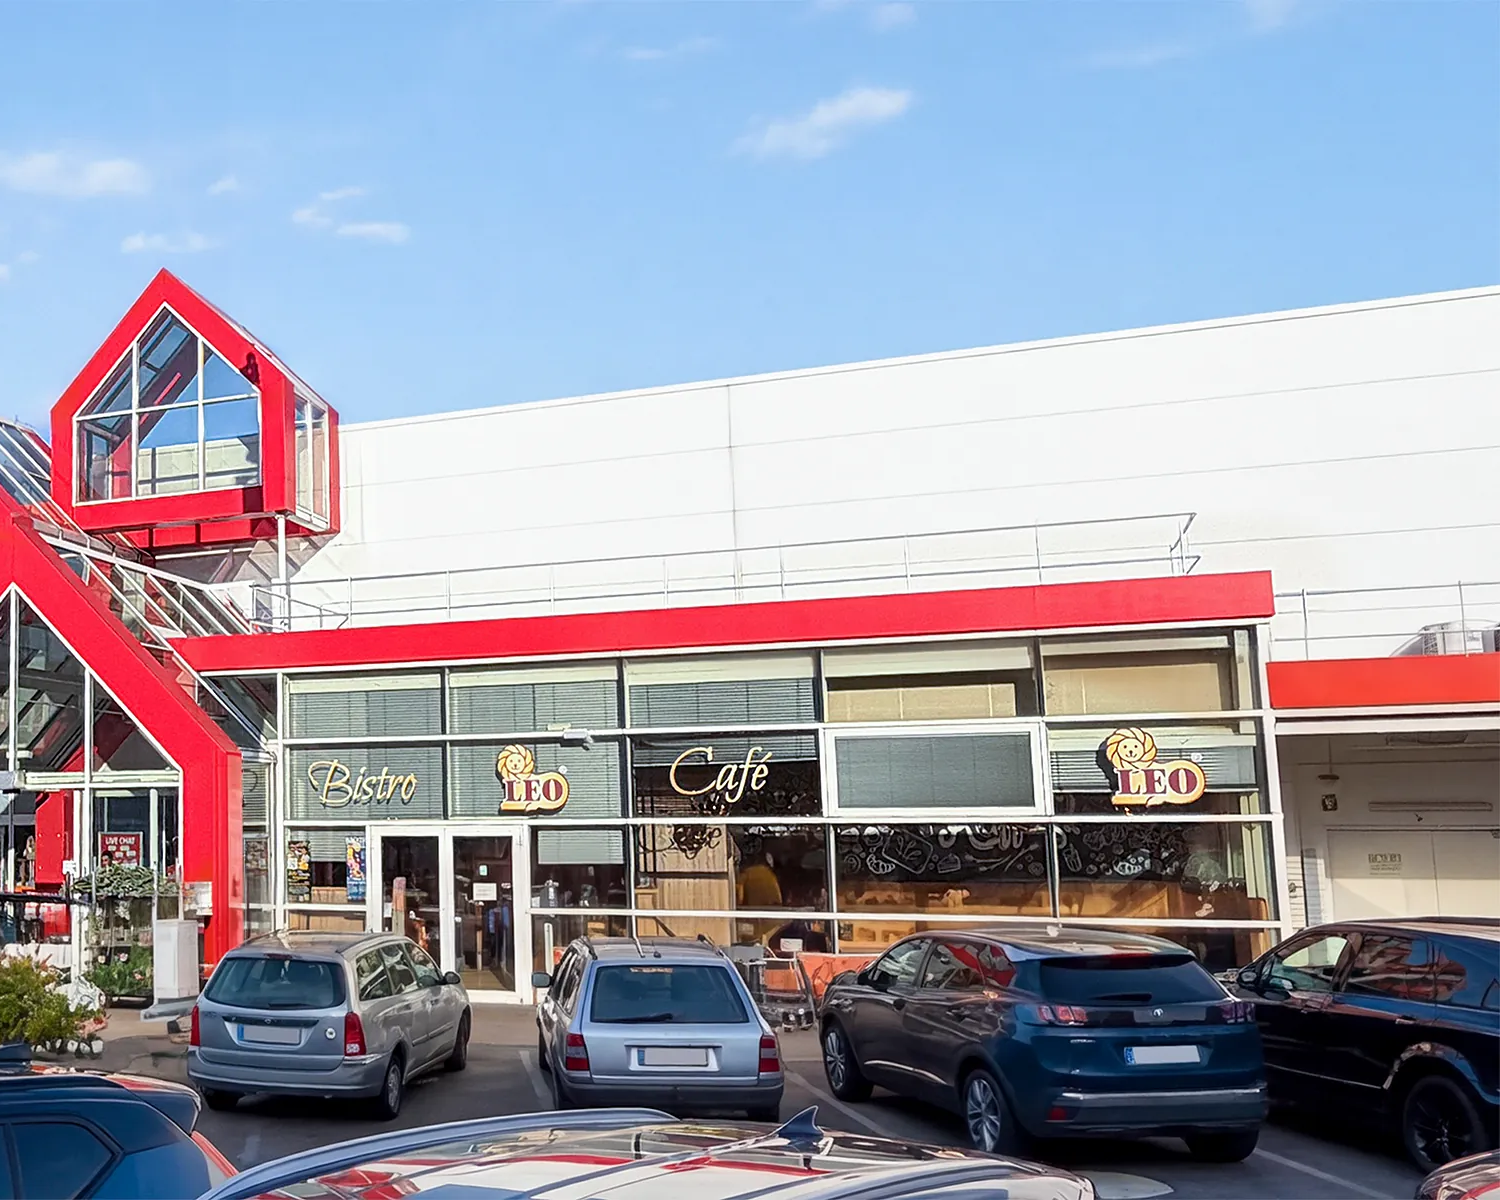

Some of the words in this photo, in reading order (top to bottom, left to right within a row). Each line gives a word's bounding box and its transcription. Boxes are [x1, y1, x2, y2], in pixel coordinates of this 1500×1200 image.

[308, 759, 418, 808] Bistro
[504, 779, 564, 803] LEO
[669, 746, 773, 803] Café
[1114, 767, 1199, 795] LEO
